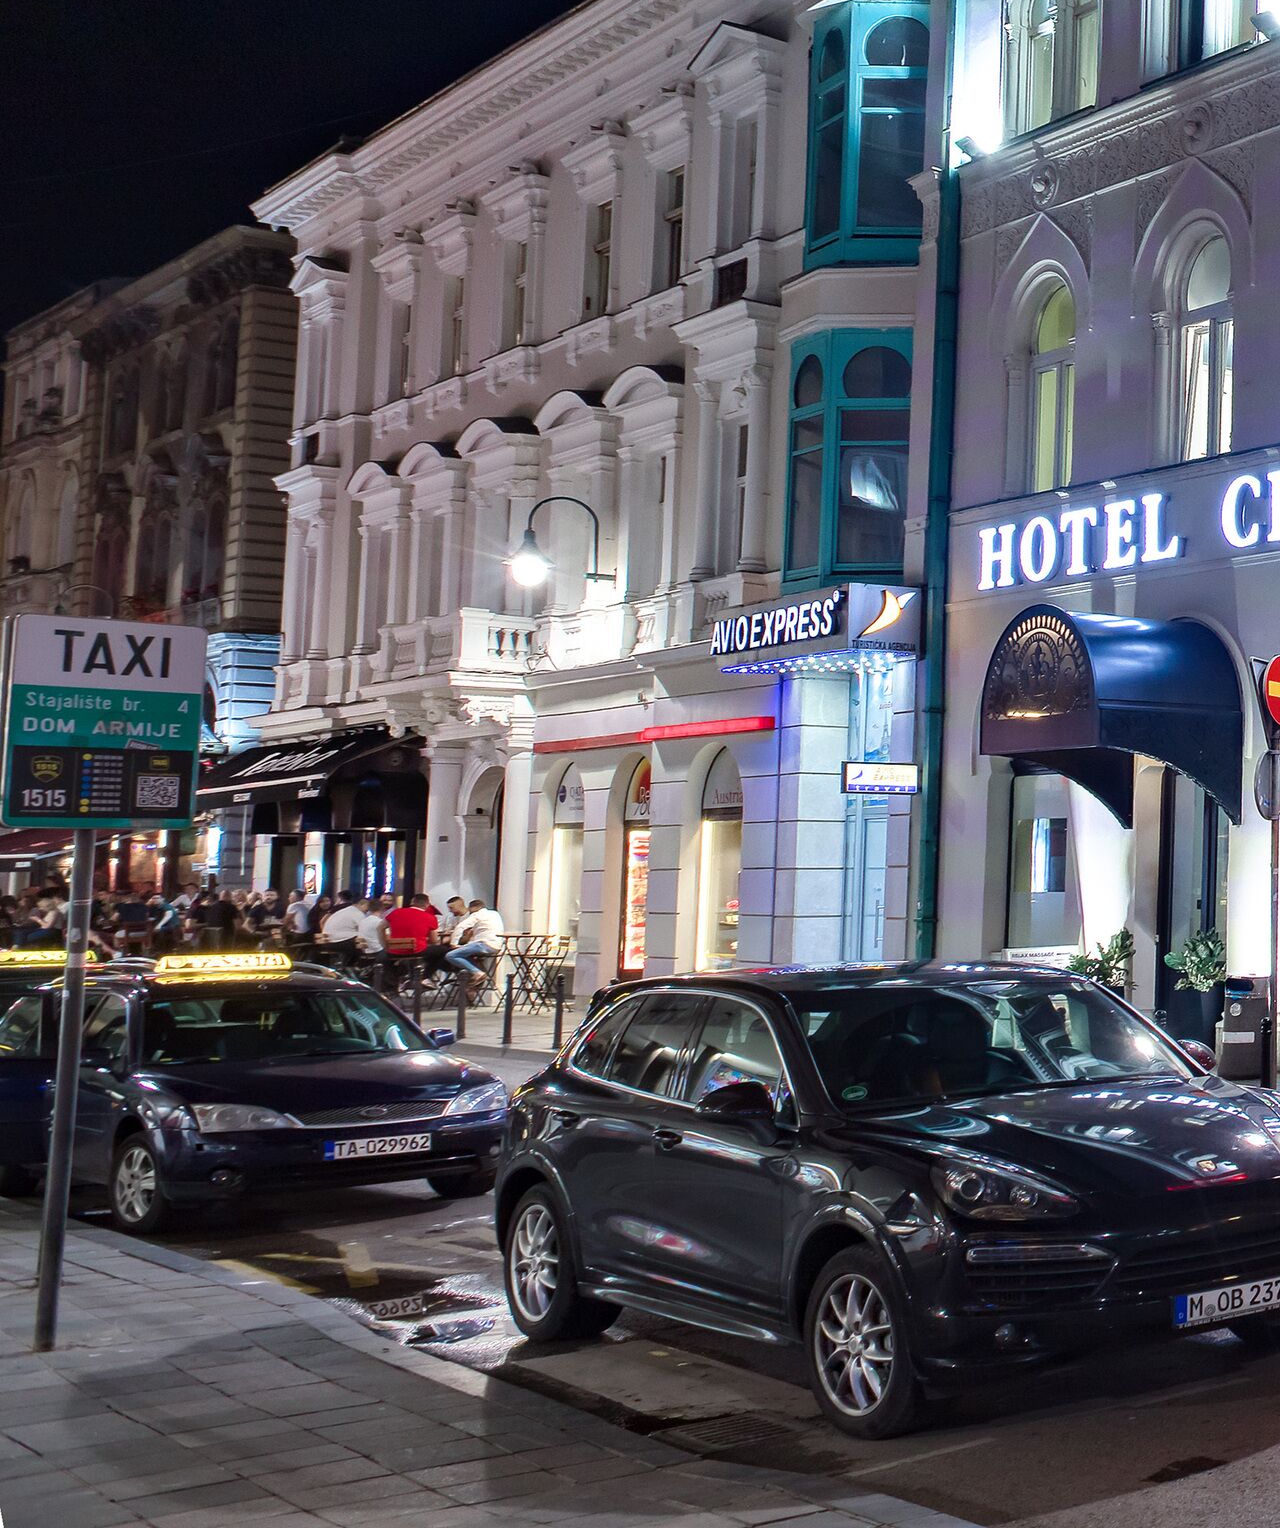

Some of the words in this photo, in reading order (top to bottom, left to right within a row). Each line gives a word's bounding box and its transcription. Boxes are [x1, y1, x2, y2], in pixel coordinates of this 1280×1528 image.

[978, 493, 1180, 590] HOTEL
[54, 629, 172, 678] TAXI
[25, 691, 112, 711] Stajalište
[122, 697, 145, 712] br.
[177, 700, 189, 713] 4
[23, 717, 75, 733] DOM
[92, 721, 181, 738] ARMIJE
[22, 789, 66, 807] 1515
[712, 788, 743, 804] Austria
[336, 1135, 430, 1157] TA-029962
[1190, 1296, 1203, 1318] M
[1218, 1288, 1244, 1312] OB
